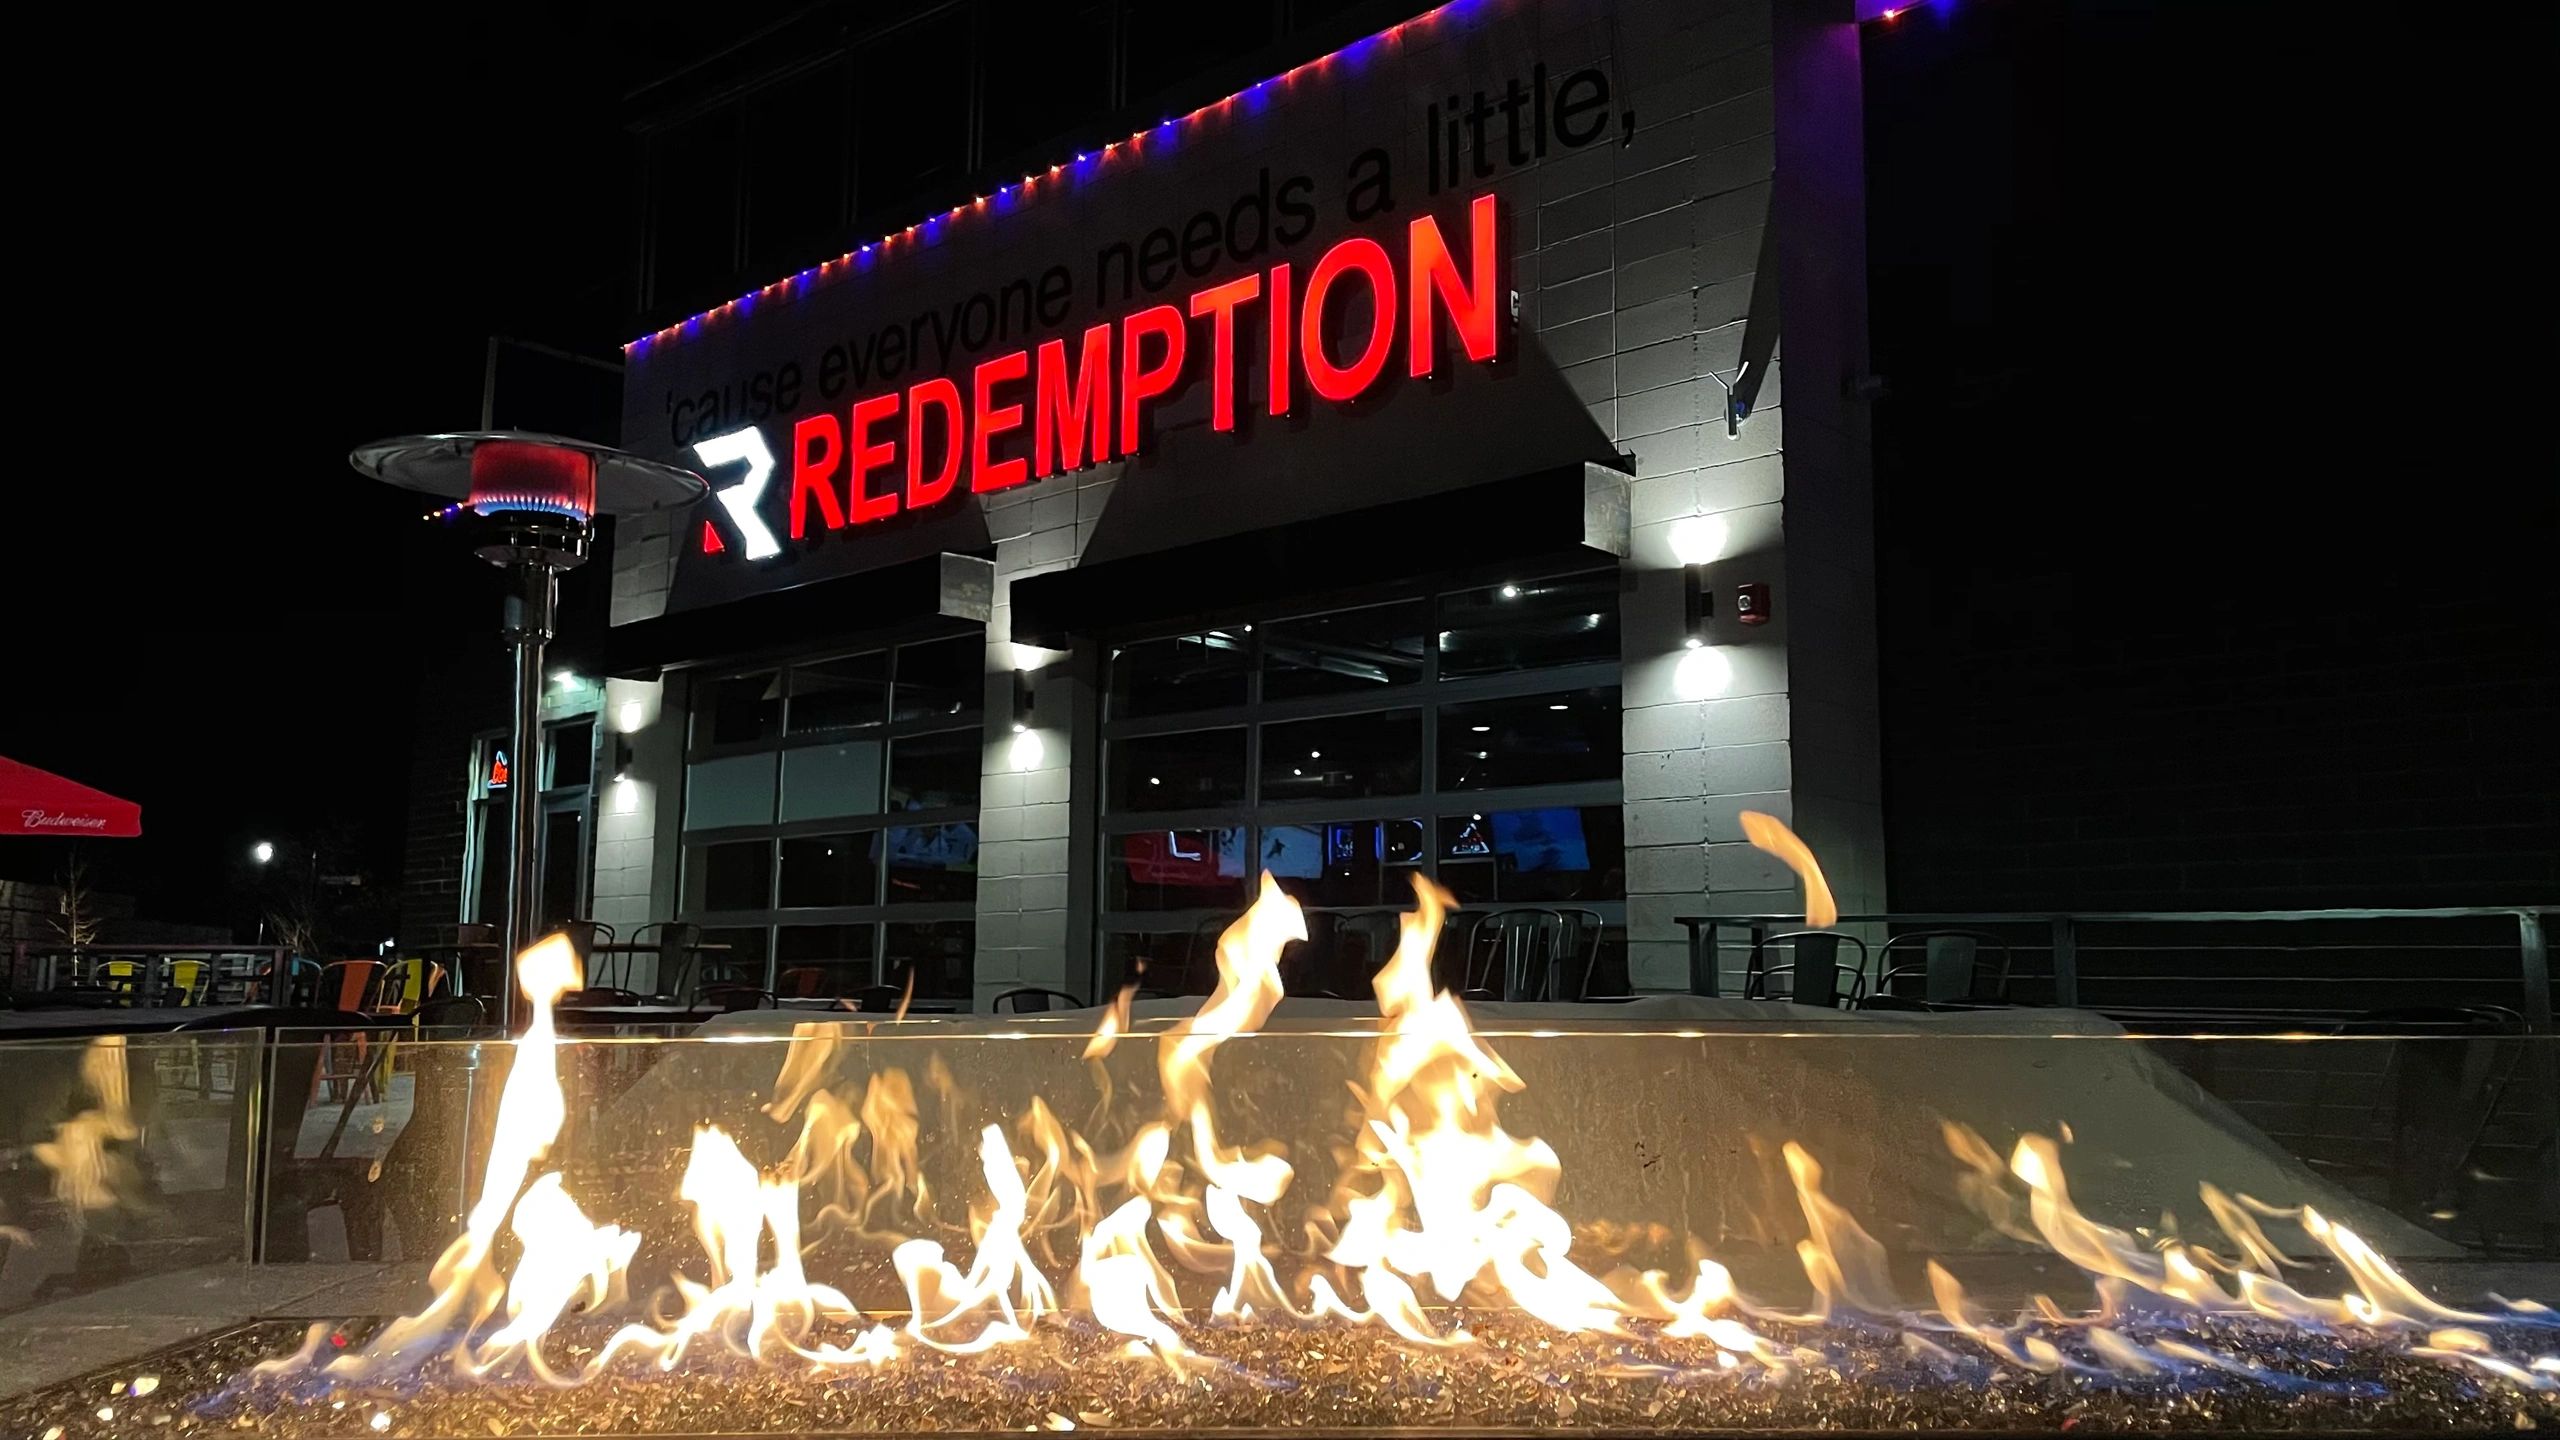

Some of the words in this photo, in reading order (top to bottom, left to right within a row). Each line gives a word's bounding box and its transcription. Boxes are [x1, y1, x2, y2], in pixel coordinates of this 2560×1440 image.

[667, 360, 802, 448] 'cause
[819, 265, 1072, 398] everyone
[1096, 167, 1316, 308] needs
[1347, 147, 1396, 223] a
[1428, 62, 1636, 195] little,
[790, 193, 1499, 539] REDEMPTION
[21, 809, 107, 830] Budweiser
